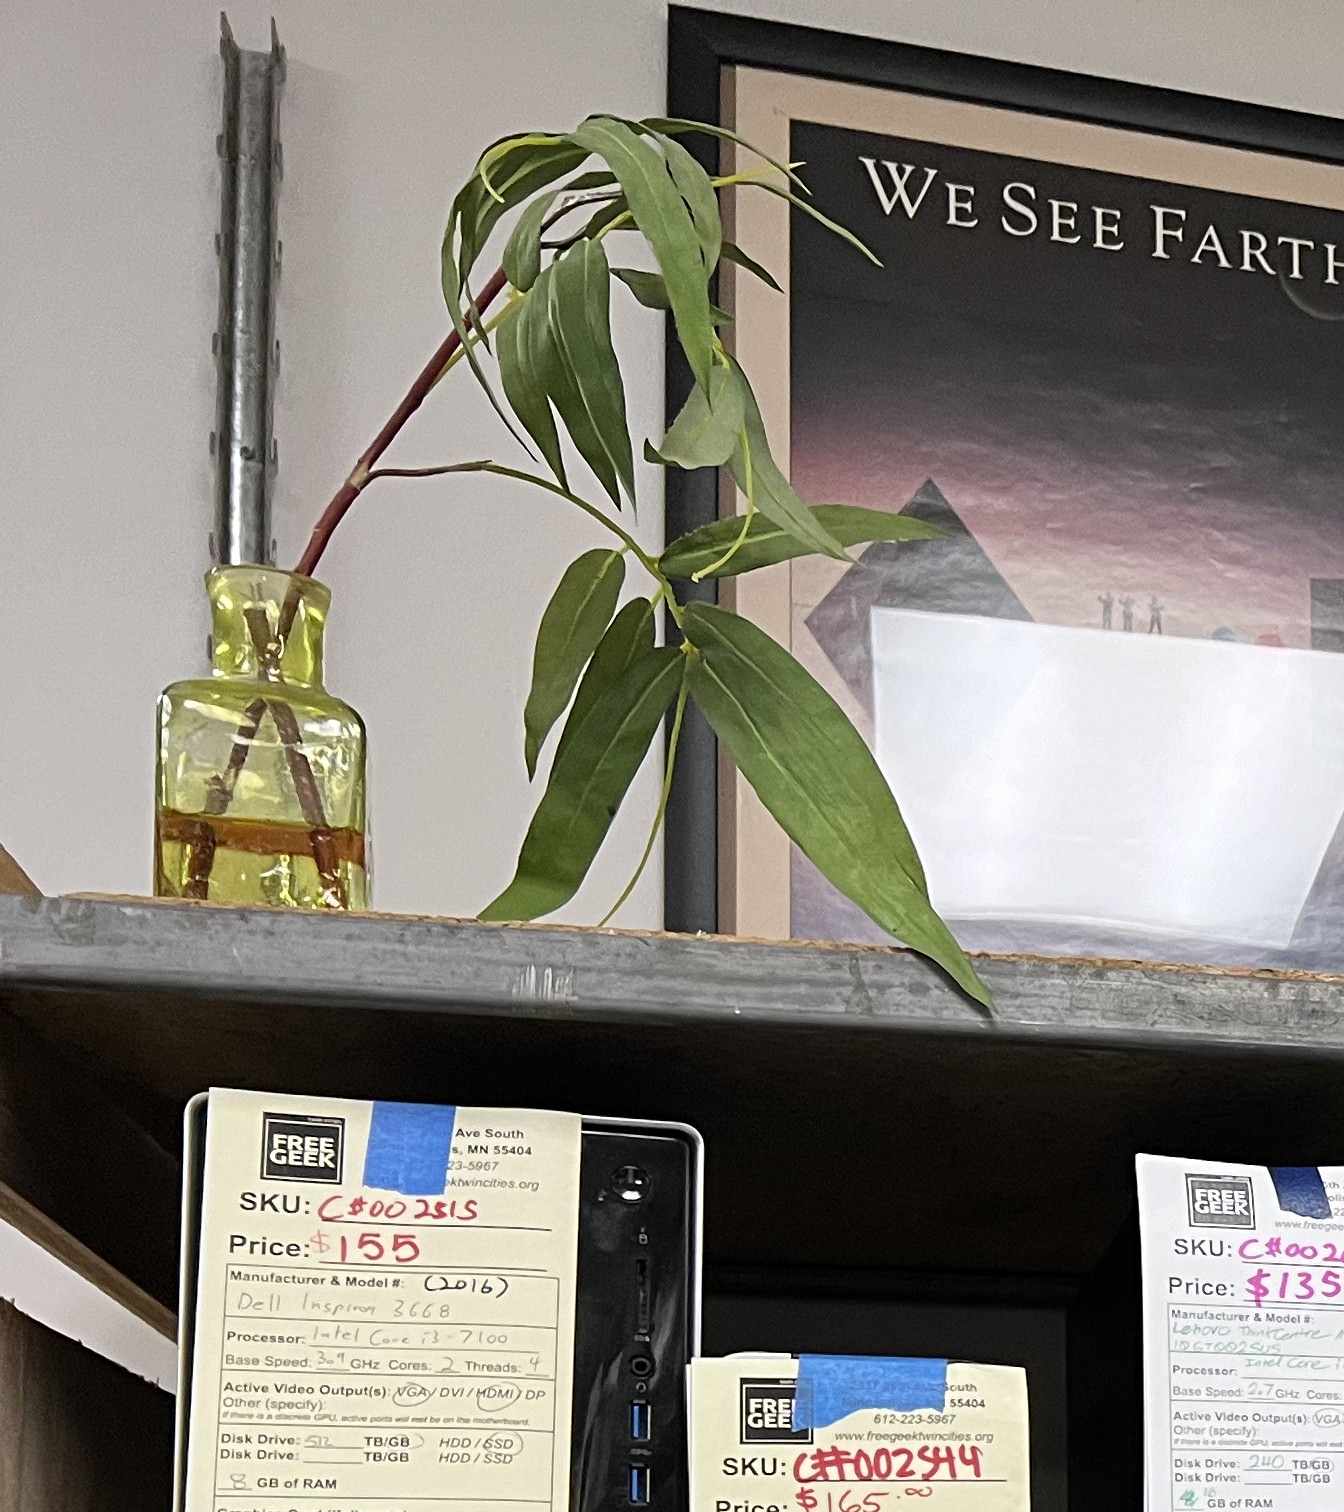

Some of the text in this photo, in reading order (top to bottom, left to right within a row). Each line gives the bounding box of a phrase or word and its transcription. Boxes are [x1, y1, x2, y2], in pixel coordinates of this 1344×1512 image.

[272, 1133, 334, 1152] FREE
[485, 1128, 524, 1139] South
[269, 1149, 336, 1169] GEEK
[468, 1145, 532, 1156] MN 55404
[239, 1193, 311, 1214] SKU:
[1195, 1189, 1247, 1203] FREE
[1194, 1200, 1249, 1216] GEEK
[229, 1235, 310, 1258] Price:
[1174, 1238, 1232, 1257] SKU:
[231, 1271, 508, 1299] Manufacturer Model (2016)
[1169, 1269, 1342, 1307] Price: $135
[238, 1292, 280, 1312] Dell
[394, 1300, 450, 1318] 3668
[227, 1331, 306, 1344] Processor:
[950, 1399, 985, 1408] 55404
[874, 1415, 956, 1424] 612-223-5967
[722, 1457, 787, 1476] SKU:
